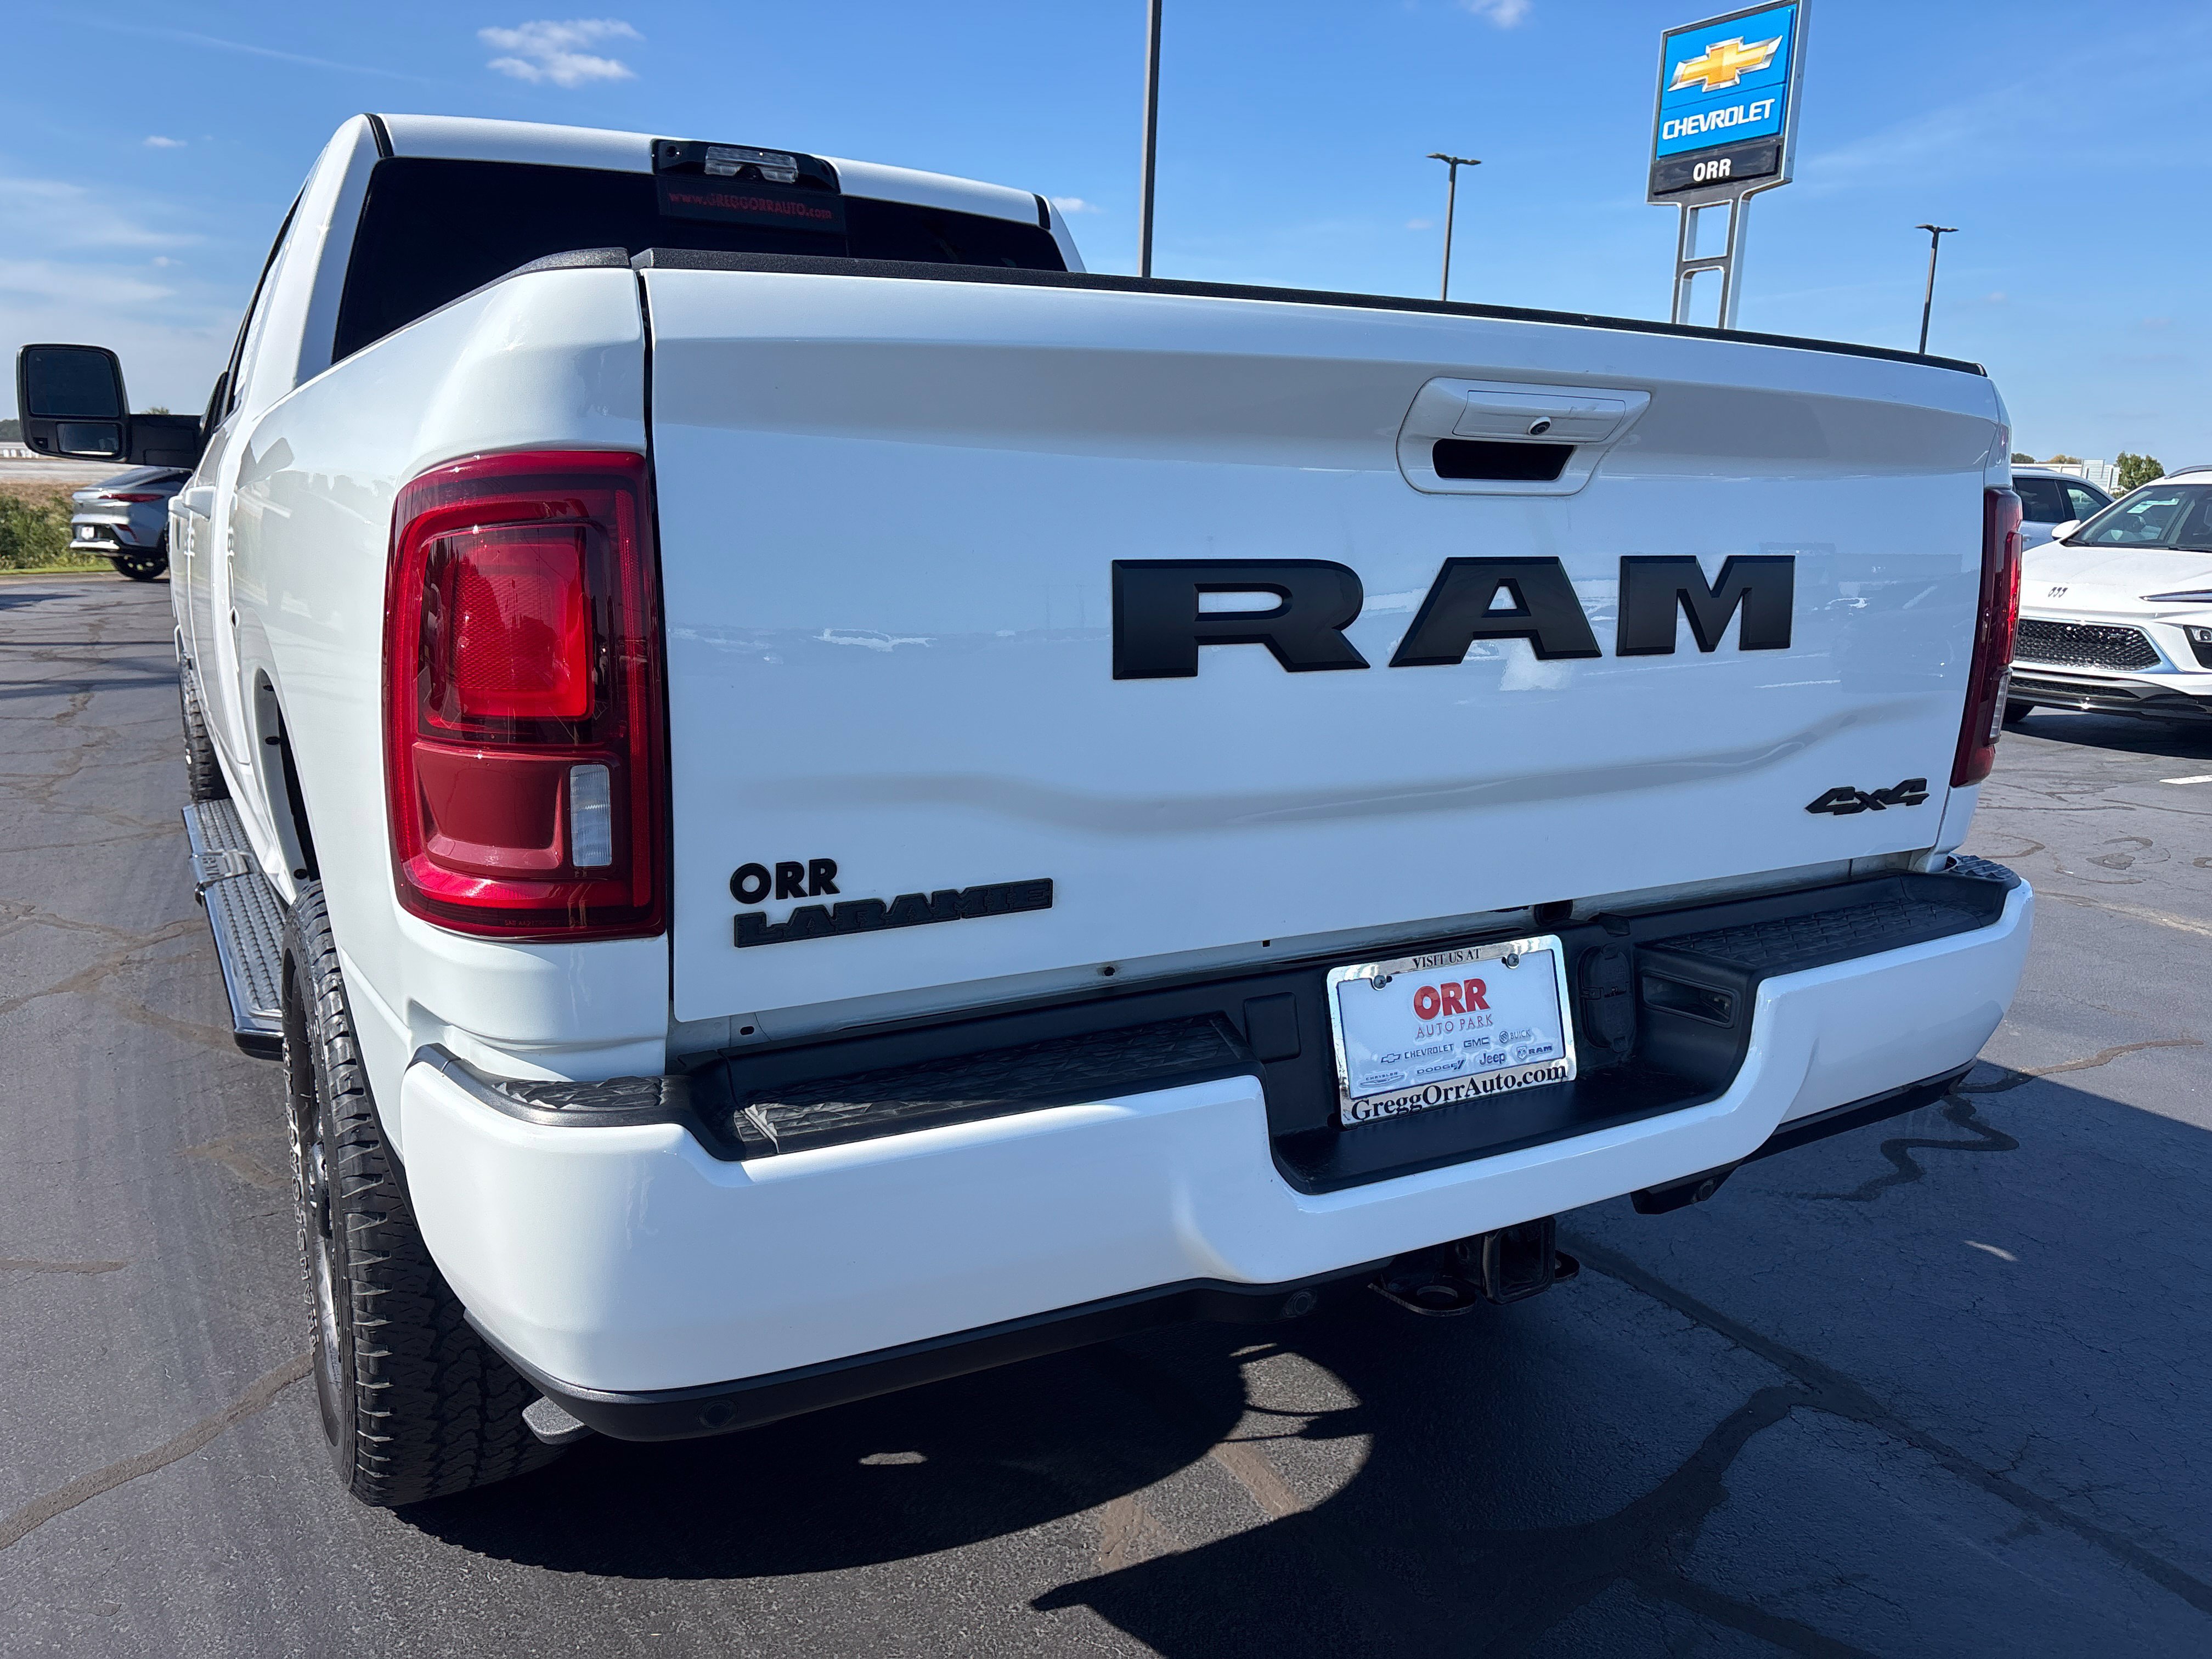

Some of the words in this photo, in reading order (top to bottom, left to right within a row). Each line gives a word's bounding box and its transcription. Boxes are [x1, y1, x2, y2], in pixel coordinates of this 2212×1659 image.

[1662, 98, 1775, 140] CHEVROLET
[1693, 159, 1731, 182] ORR
[1112, 555, 1795, 680] RAM
[730, 858, 840, 904] ORR
[733, 878, 1053, 948] LARAMIE
[1413, 953, 1445, 969] VISIT
[1449, 951, 1463, 963] US
[1466, 949, 1481, 961] AT
[1414, 978, 1491, 1020] ORR
[1417, 1021, 1454, 1038] AUTO
[1459, 1014, 1493, 1031] PARK
[1510, 1029, 1531, 1040] BUICK
[1404, 1043, 1454, 1059] CHEVROLET
[1464, 1037, 1489, 1048] GMC
[1528, 1045, 1552, 1054] RAM
[1417, 1063, 1458, 1074] DODGE
[1480, 1053, 1506, 1065] Jeep
[1365, 1071, 1398, 1081] CHRYSLER
[1351, 1065, 1567, 1121] GreggOrrAuto.com
